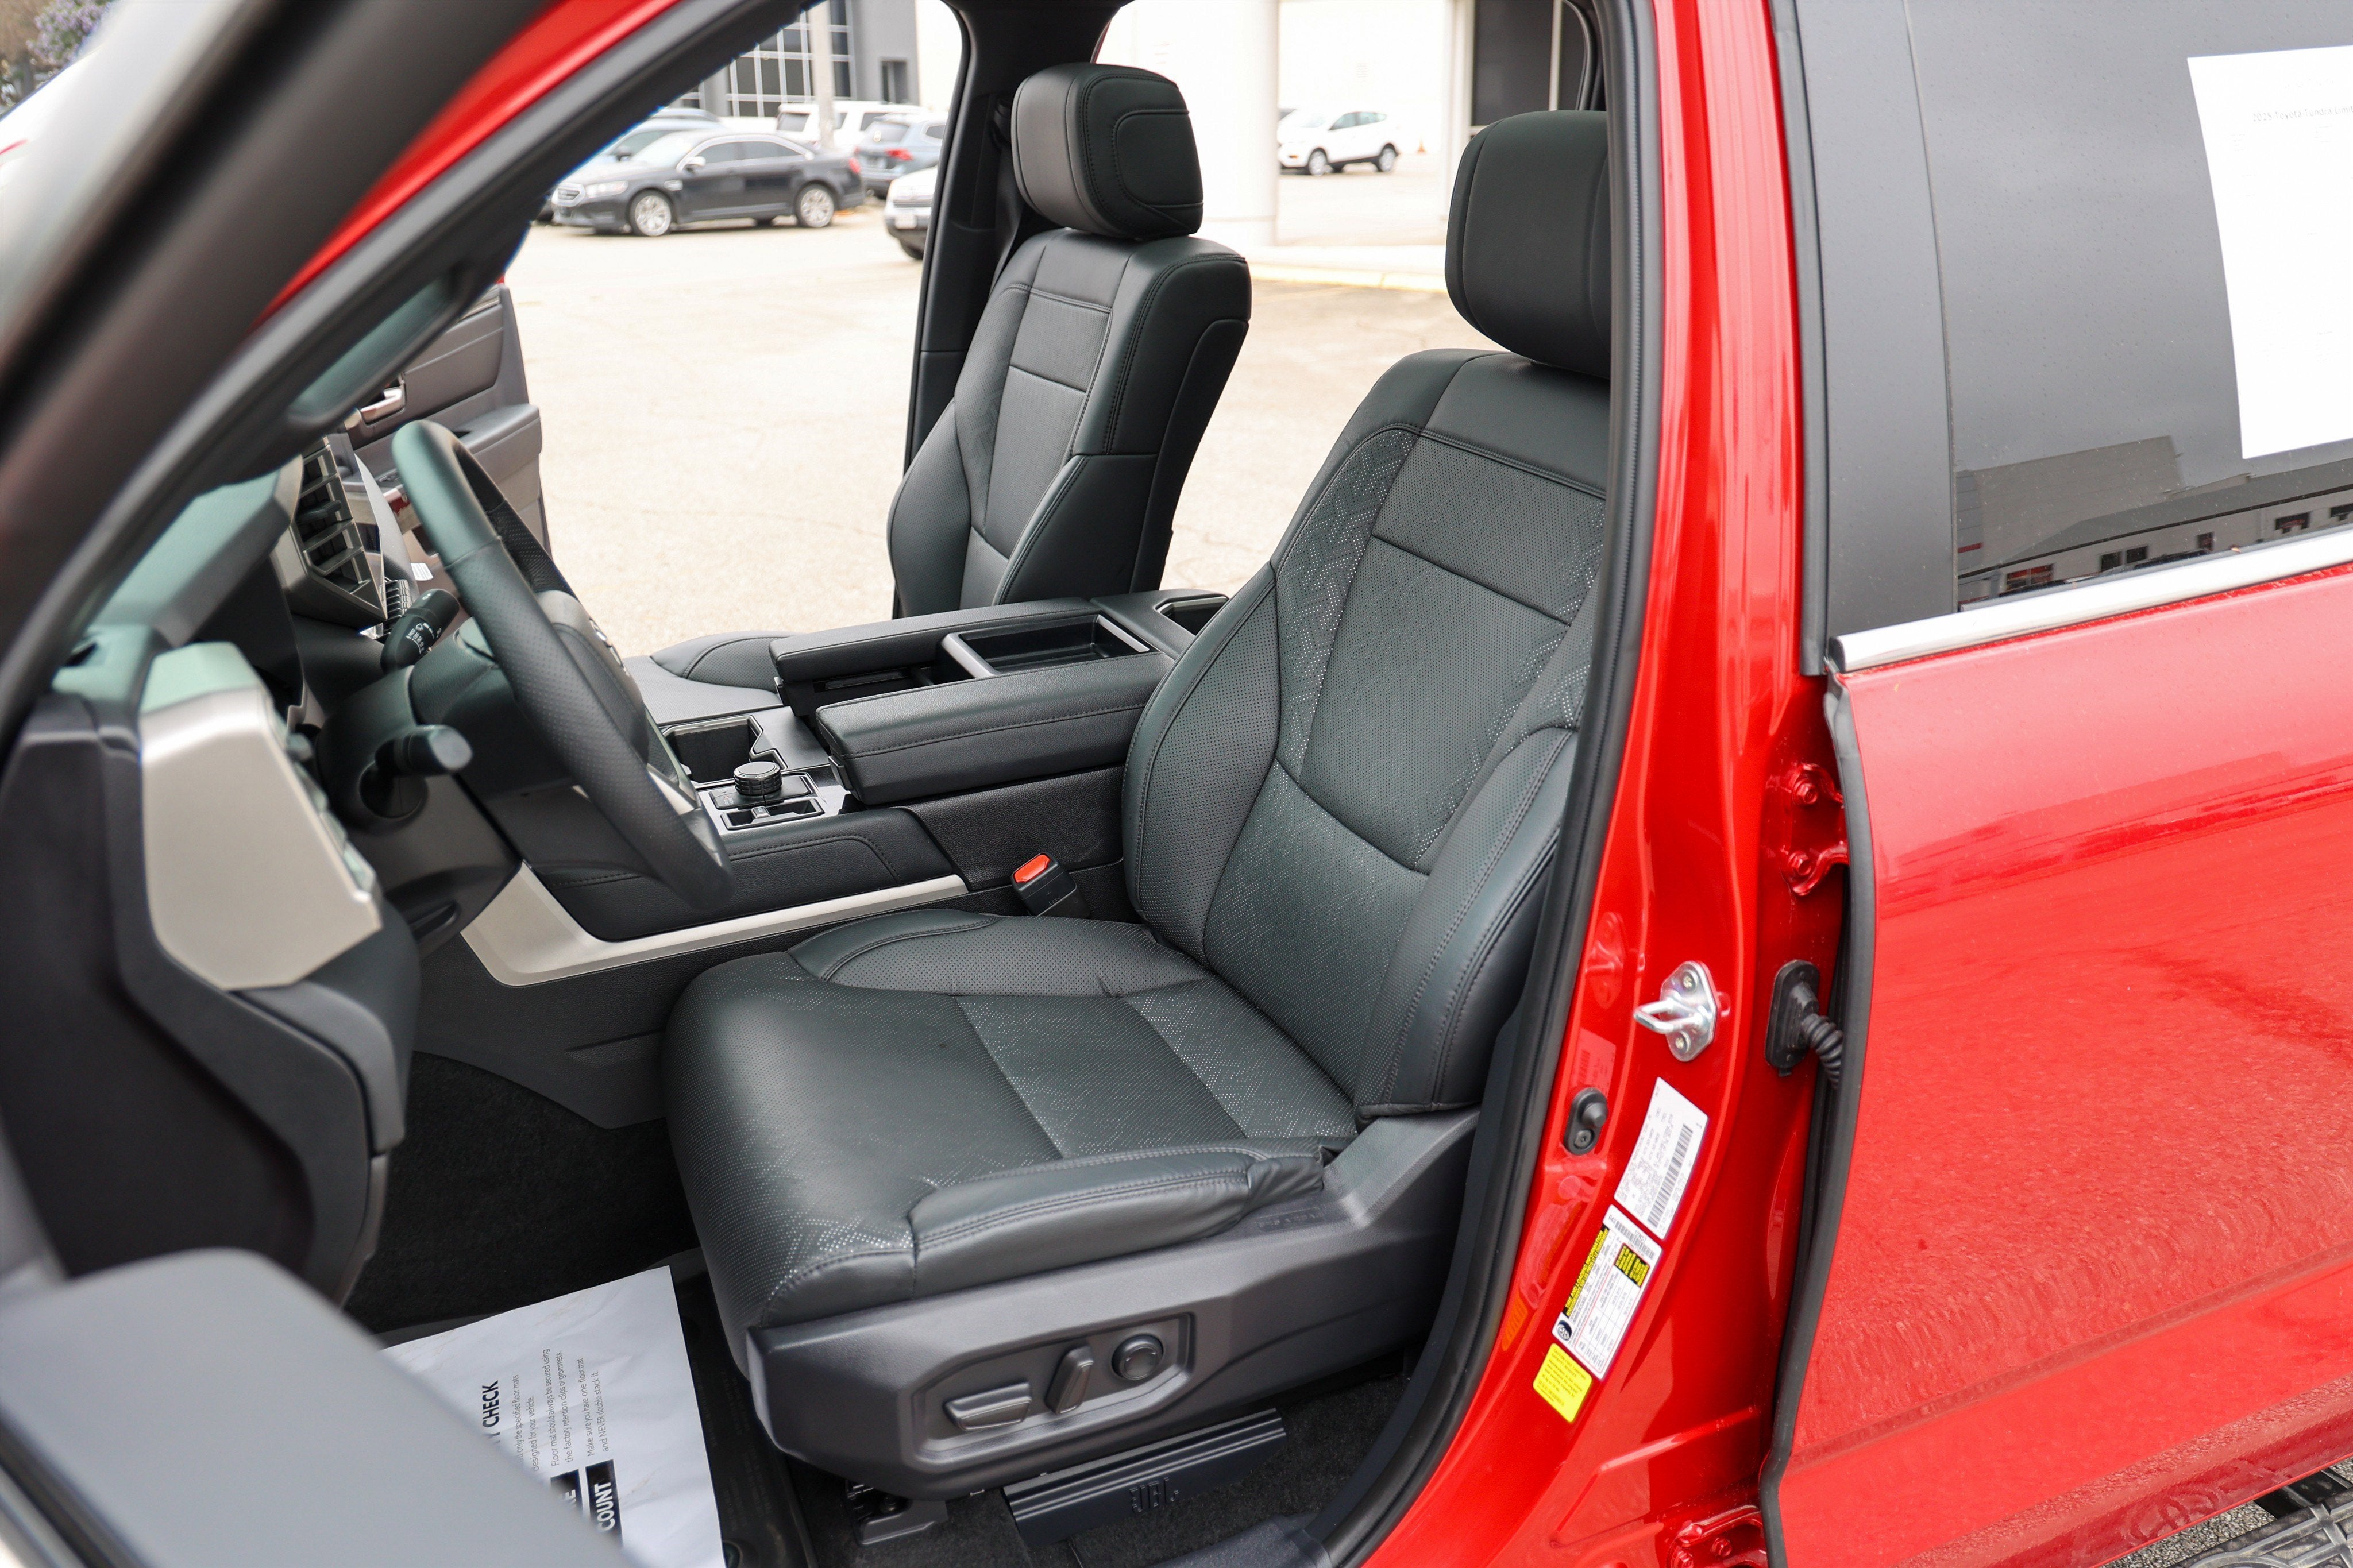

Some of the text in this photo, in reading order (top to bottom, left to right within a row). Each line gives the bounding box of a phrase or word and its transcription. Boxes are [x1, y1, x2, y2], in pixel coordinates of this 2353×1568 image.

[2275, 111, 2302, 121] Toyota
[2305, 108, 2333, 117] Tundra
[555, 1350, 566, 1380] grommets.
[577, 1369, 586, 1383] floor
[558, 1387, 568, 1400] clips
[592, 1378, 601, 1395] stack
[481, 1380, 500, 1428] CHECK
[512, 1390, 520, 1403] floor
[582, 1397, 590, 1412] have
[526, 1395, 535, 1417] vehicle.
[542, 1348, 560, 1466] Floor mat should always be secured using
[560, 1401, 570, 1427] retention
[594, 1396, 605, 1415] double
[512, 1403, 523, 1430] specified
[584, 1412, 593, 1422] you
[529, 1419, 538, 1432] your
[585, 1422, 593, 1436] sure
[596, 1415, 607, 1438] NEVER
[514, 1430, 523, 1439] the
[564, 1427, 572, 1449] factory
[515, 1440, 524, 1453] only
[585, 1437, 596, 1457] Make
[599, 1438, 609, 1452] and
[529, 1440, 540, 1472] designed
[565, 1450, 573, 1462] the
[594, 1482, 615, 1532] COUNT
